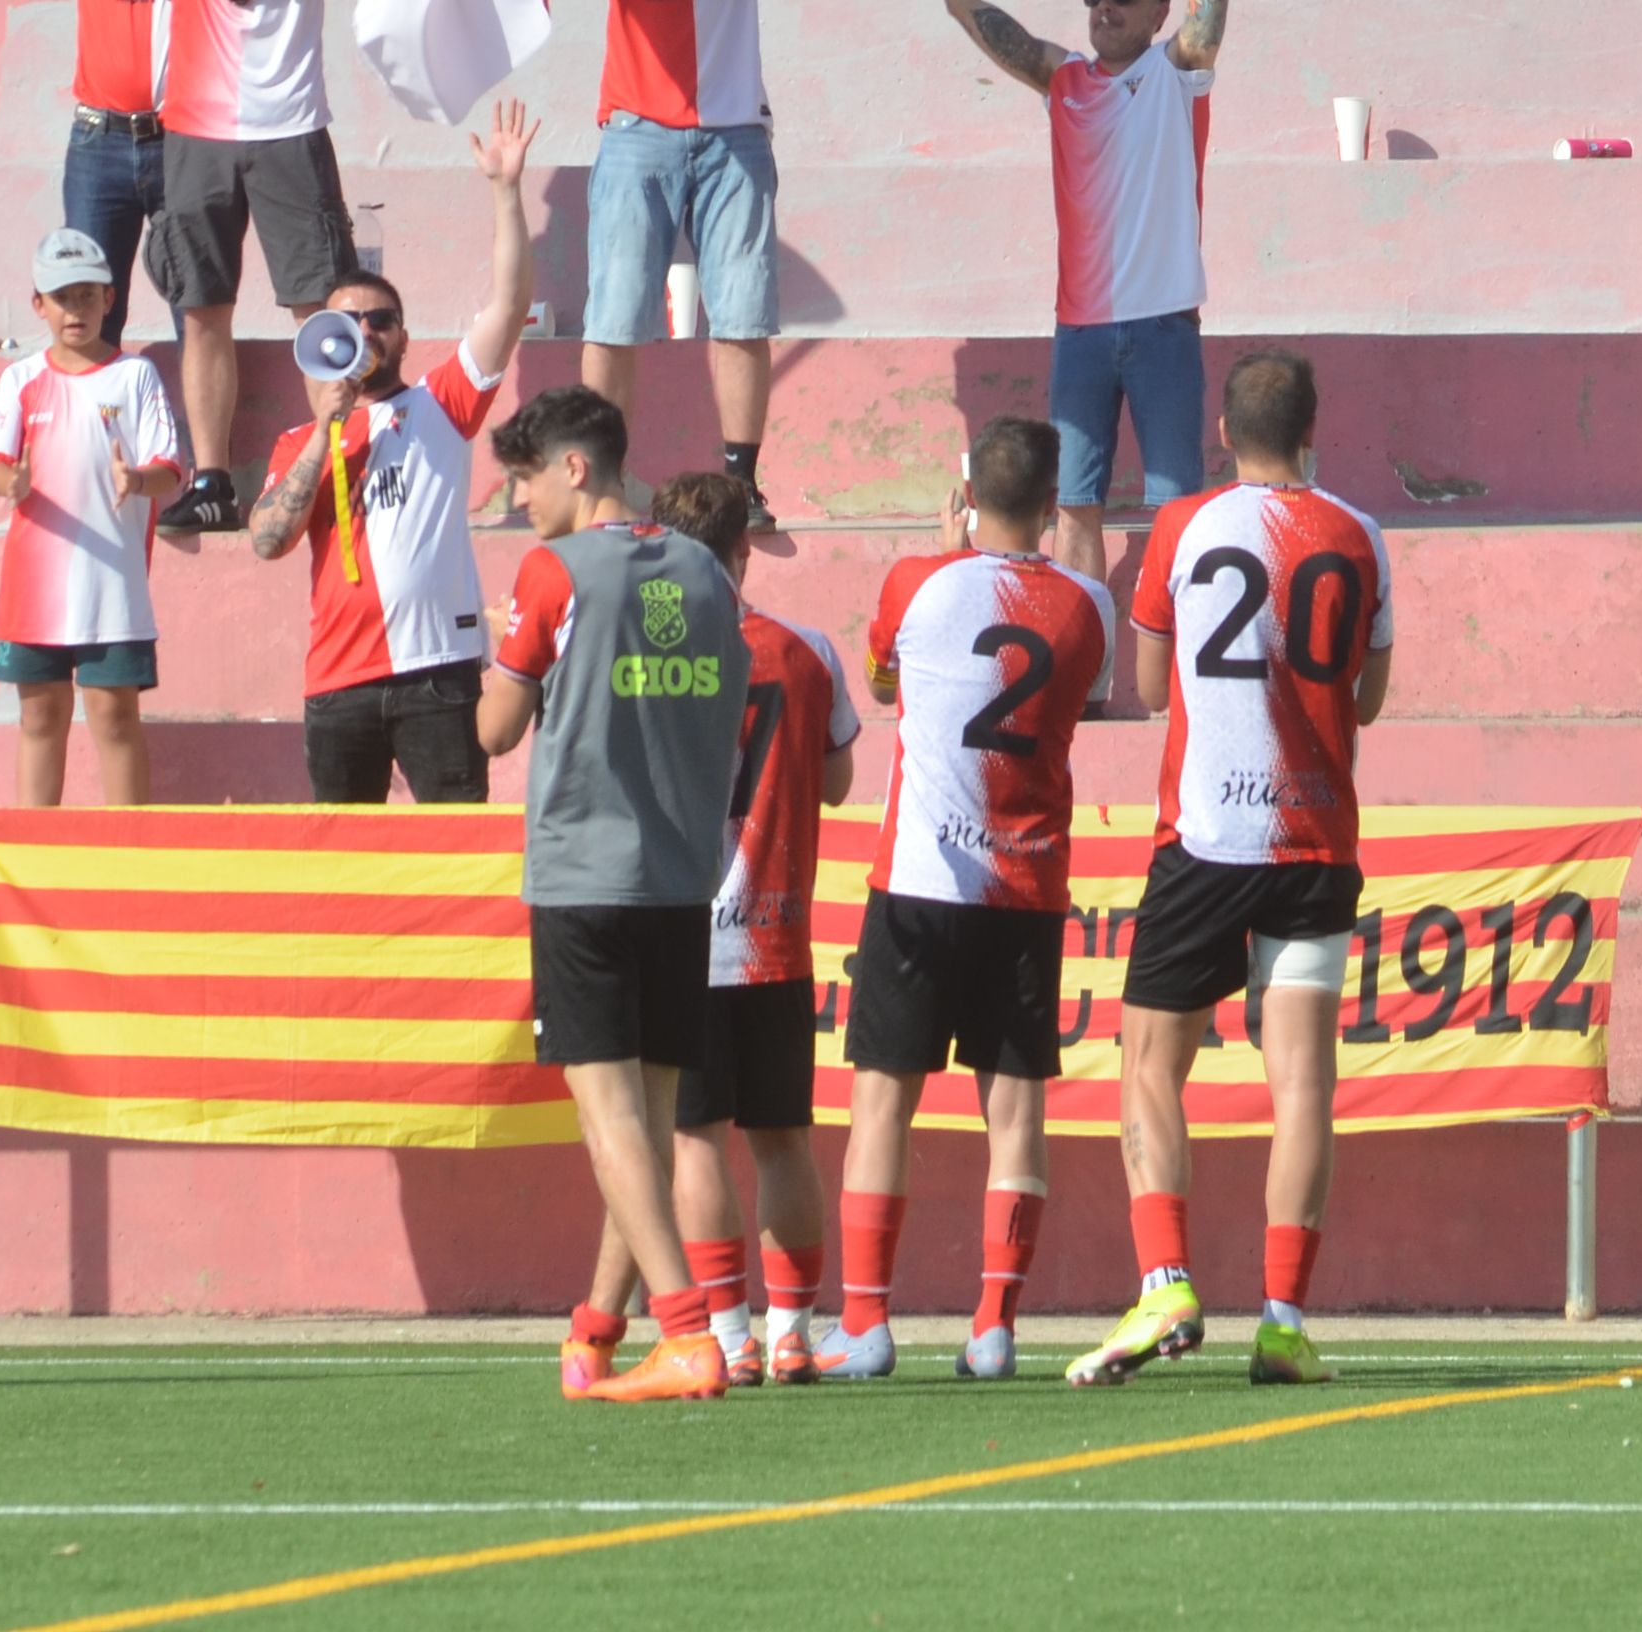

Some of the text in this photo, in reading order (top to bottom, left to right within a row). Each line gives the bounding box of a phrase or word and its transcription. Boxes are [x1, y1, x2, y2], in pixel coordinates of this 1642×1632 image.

[610, 654, 721, 698] GIOS
[1190, 545, 1362, 685] 20
[961, 624, 1054, 759] 2
[1343, 890, 1596, 1045] 1912
